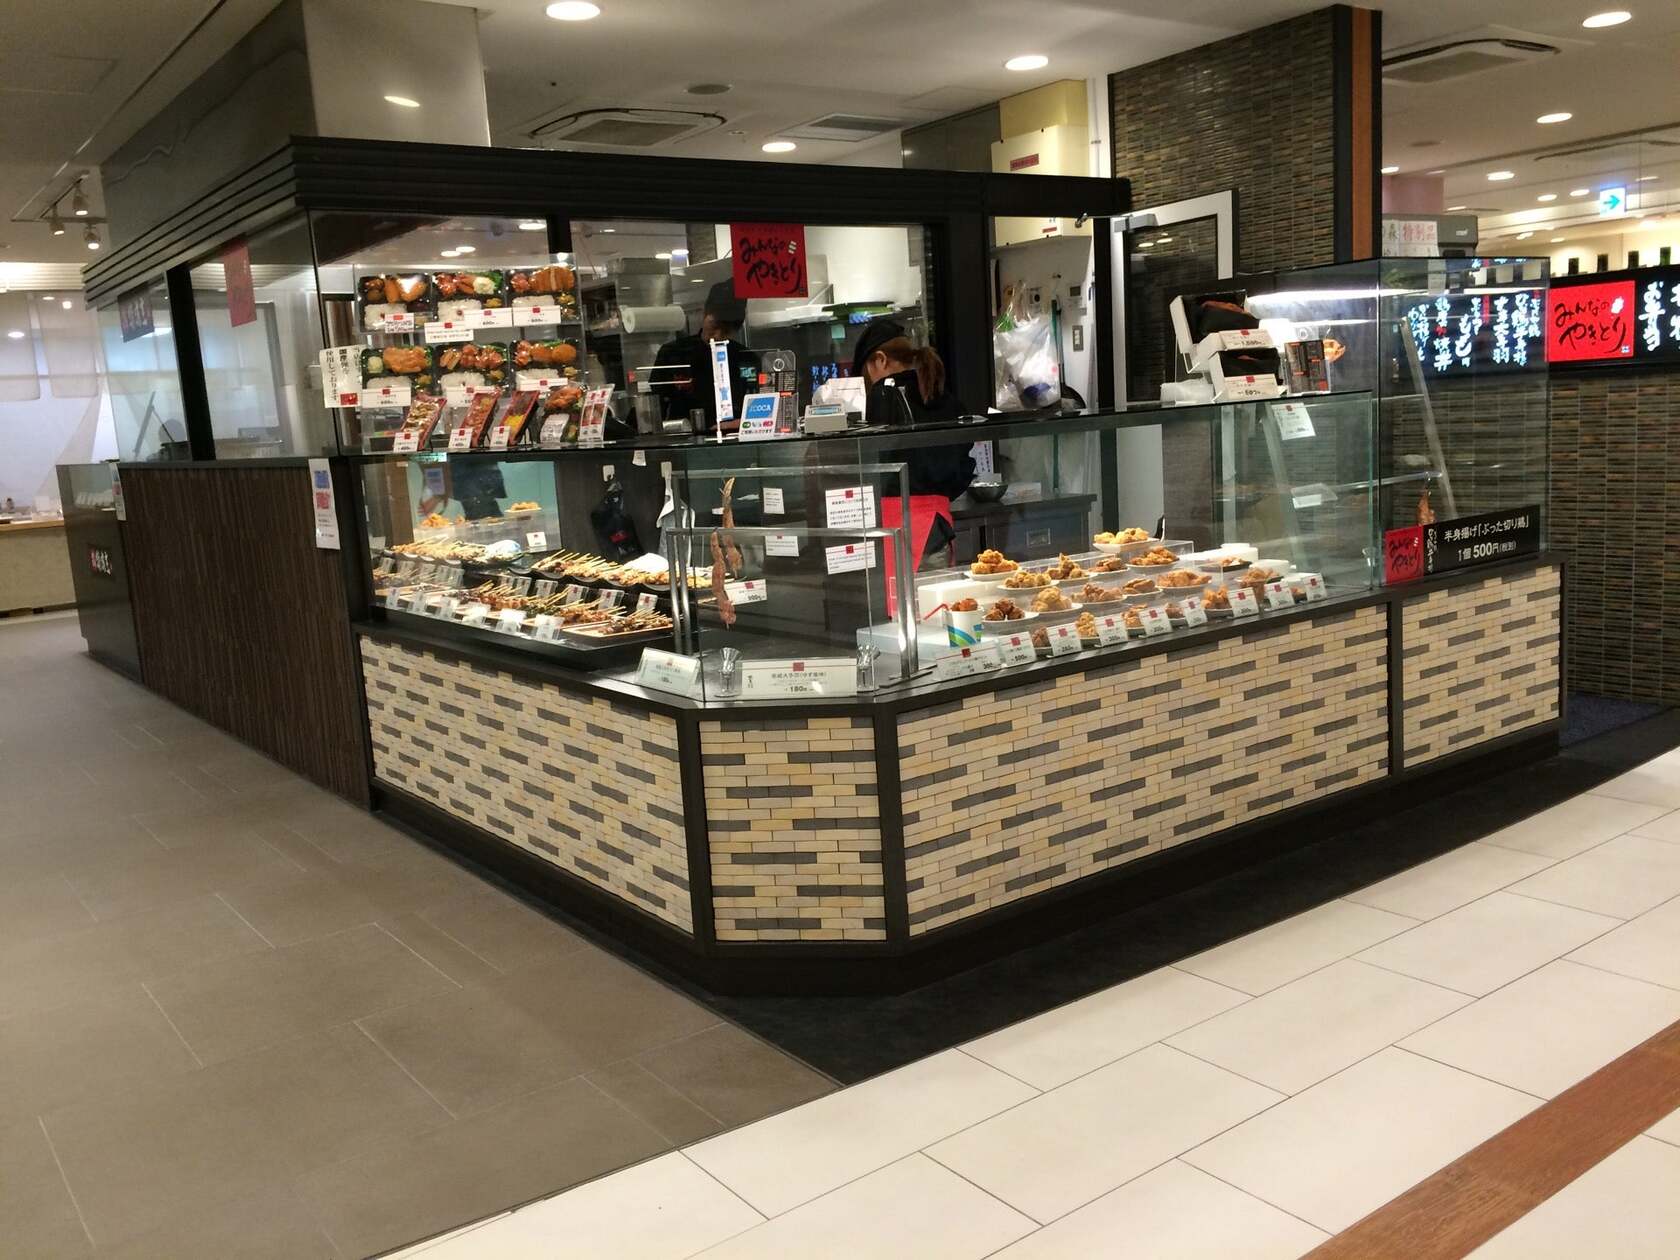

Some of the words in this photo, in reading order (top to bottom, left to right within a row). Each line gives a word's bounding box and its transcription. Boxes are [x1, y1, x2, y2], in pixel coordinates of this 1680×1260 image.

[1554, 300, 1611, 325] みんなの
[1638, 281, 1666, 351] お弁当
[1559, 316, 1628, 354] やきとり
